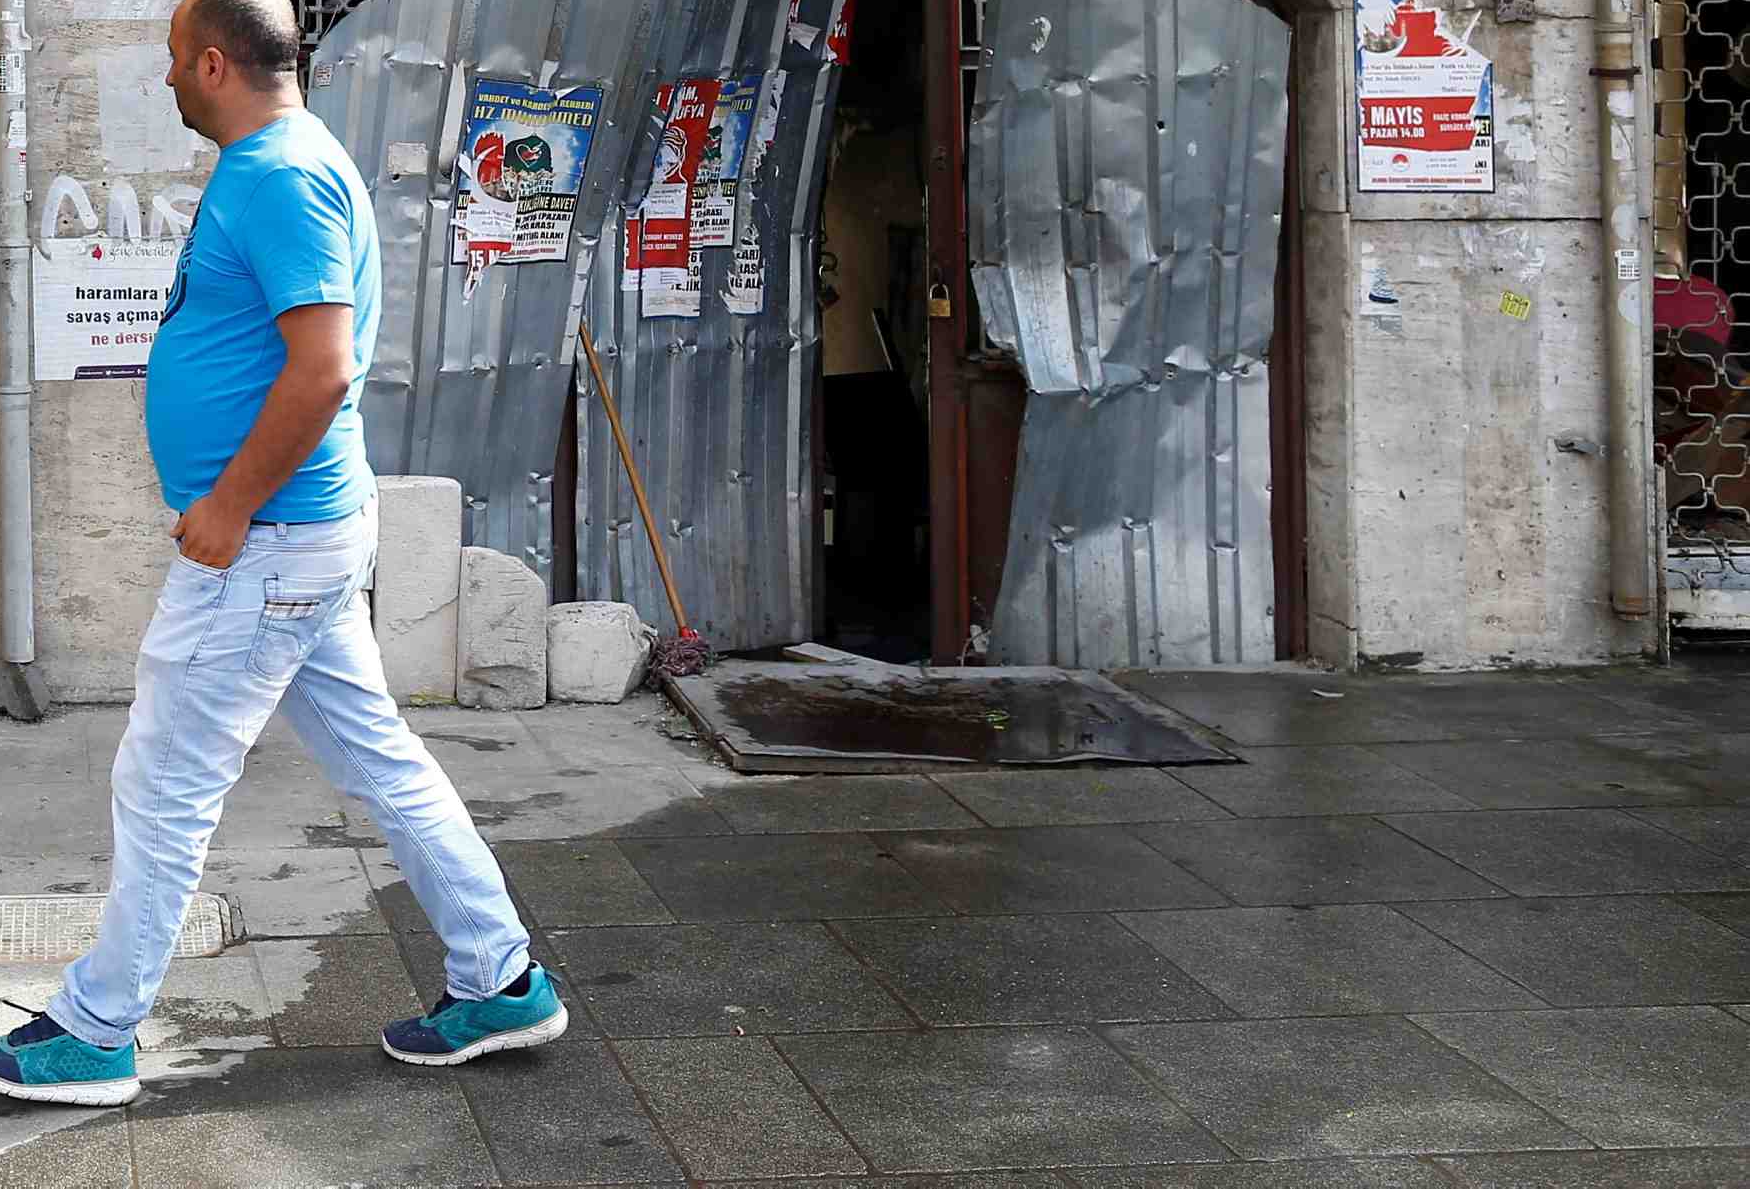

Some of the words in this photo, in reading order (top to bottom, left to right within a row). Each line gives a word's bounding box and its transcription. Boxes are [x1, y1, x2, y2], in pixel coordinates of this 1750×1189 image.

[1370, 128, 1399, 139] PAZAR
[1400, 127, 1426, 139] 14.00
[75, 286, 159, 301] haramlara
[66, 311, 111, 325] savaş
[91, 334, 110, 346] ne
